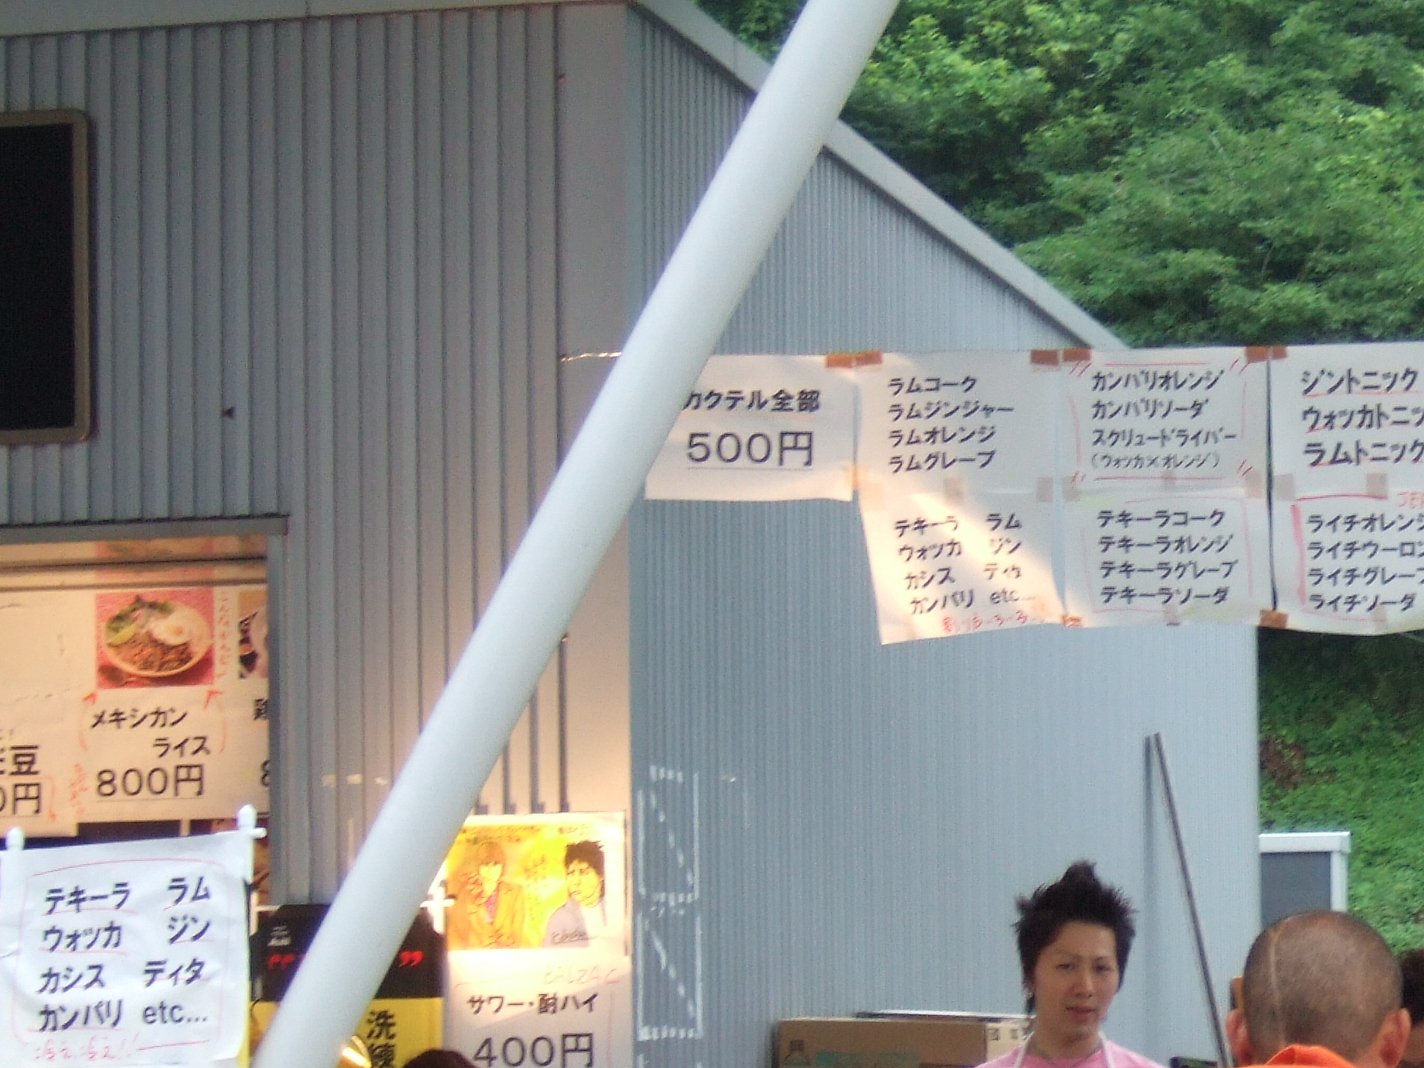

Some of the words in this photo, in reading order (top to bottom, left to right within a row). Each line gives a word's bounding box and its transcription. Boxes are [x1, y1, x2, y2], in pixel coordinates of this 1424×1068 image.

[887, 374, 977, 395] ラムコーク
[1302, 366, 1419, 394] ジントニック
[887, 399, 1014, 421] ラムジンジャー
[887, 425, 998, 447] ラムオレンジ
[1092, 427, 1238, 447] スクリュードライバー
[687, 430, 814, 467] 500円
[887, 449, 998, 474] ラムグレープ
[894, 514, 959, 537] テキーラ
[986, 513, 1023, 530] ラム
[1097, 509, 1226, 529] テキーラコーク
[898, 538, 964, 563] ウォッカ
[989, 537, 1024, 556] ジン
[1099, 534, 1235, 555] テキーラオレンジ
[904, 566, 956, 591] カシス
[1100, 558, 1239, 580] テキーラグレープ
[1101, 585, 1231, 606] テキーラソーダ
[1307, 592, 1417, 613] ライチソーダ
[90, 707, 188, 729] メキシカン
[153, 735, 211, 758] ライス
[96, 763, 205, 798] 800円
[44, 882, 131, 915] テキーラ
[166, 876, 212, 903] ラム
[42, 918, 123, 951] ウォッカ
[167, 914, 211, 946] ジン
[38, 963, 106, 996] カシス
